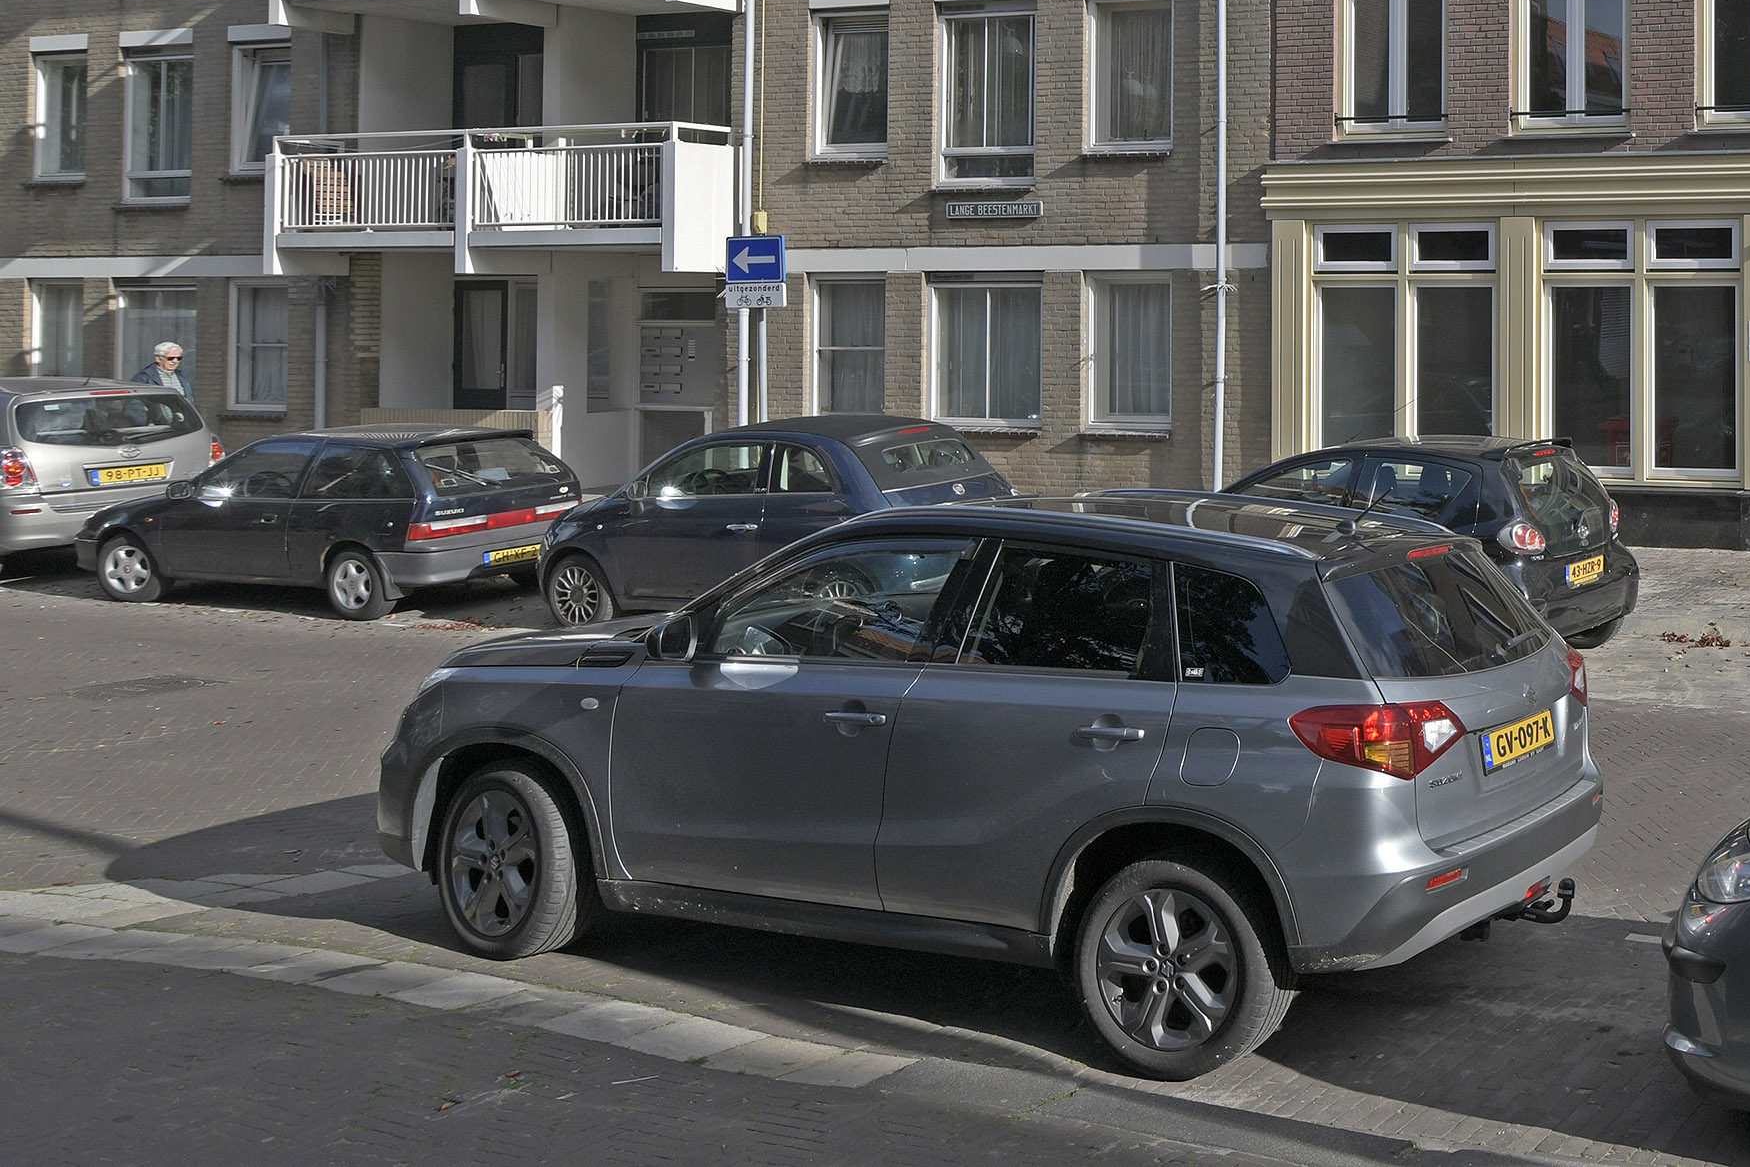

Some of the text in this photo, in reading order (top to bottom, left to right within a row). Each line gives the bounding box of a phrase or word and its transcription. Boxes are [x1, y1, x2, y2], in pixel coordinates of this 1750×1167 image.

[950, 204, 1038, 216] LANGE BEESTENMARKT
[728, 285, 780, 293] uitgezonderd
[106, 467, 159, 480] 98-PT-JJ
[435, 508, 464, 516] SUZUKI
[494, 546, 538, 563] GH-XF-2
[1571, 559, 1601, 578] 43-HZR-9
[1496, 716, 1551, 758] GV-097-K
[1429, 771, 1463, 789] SUZUKI
